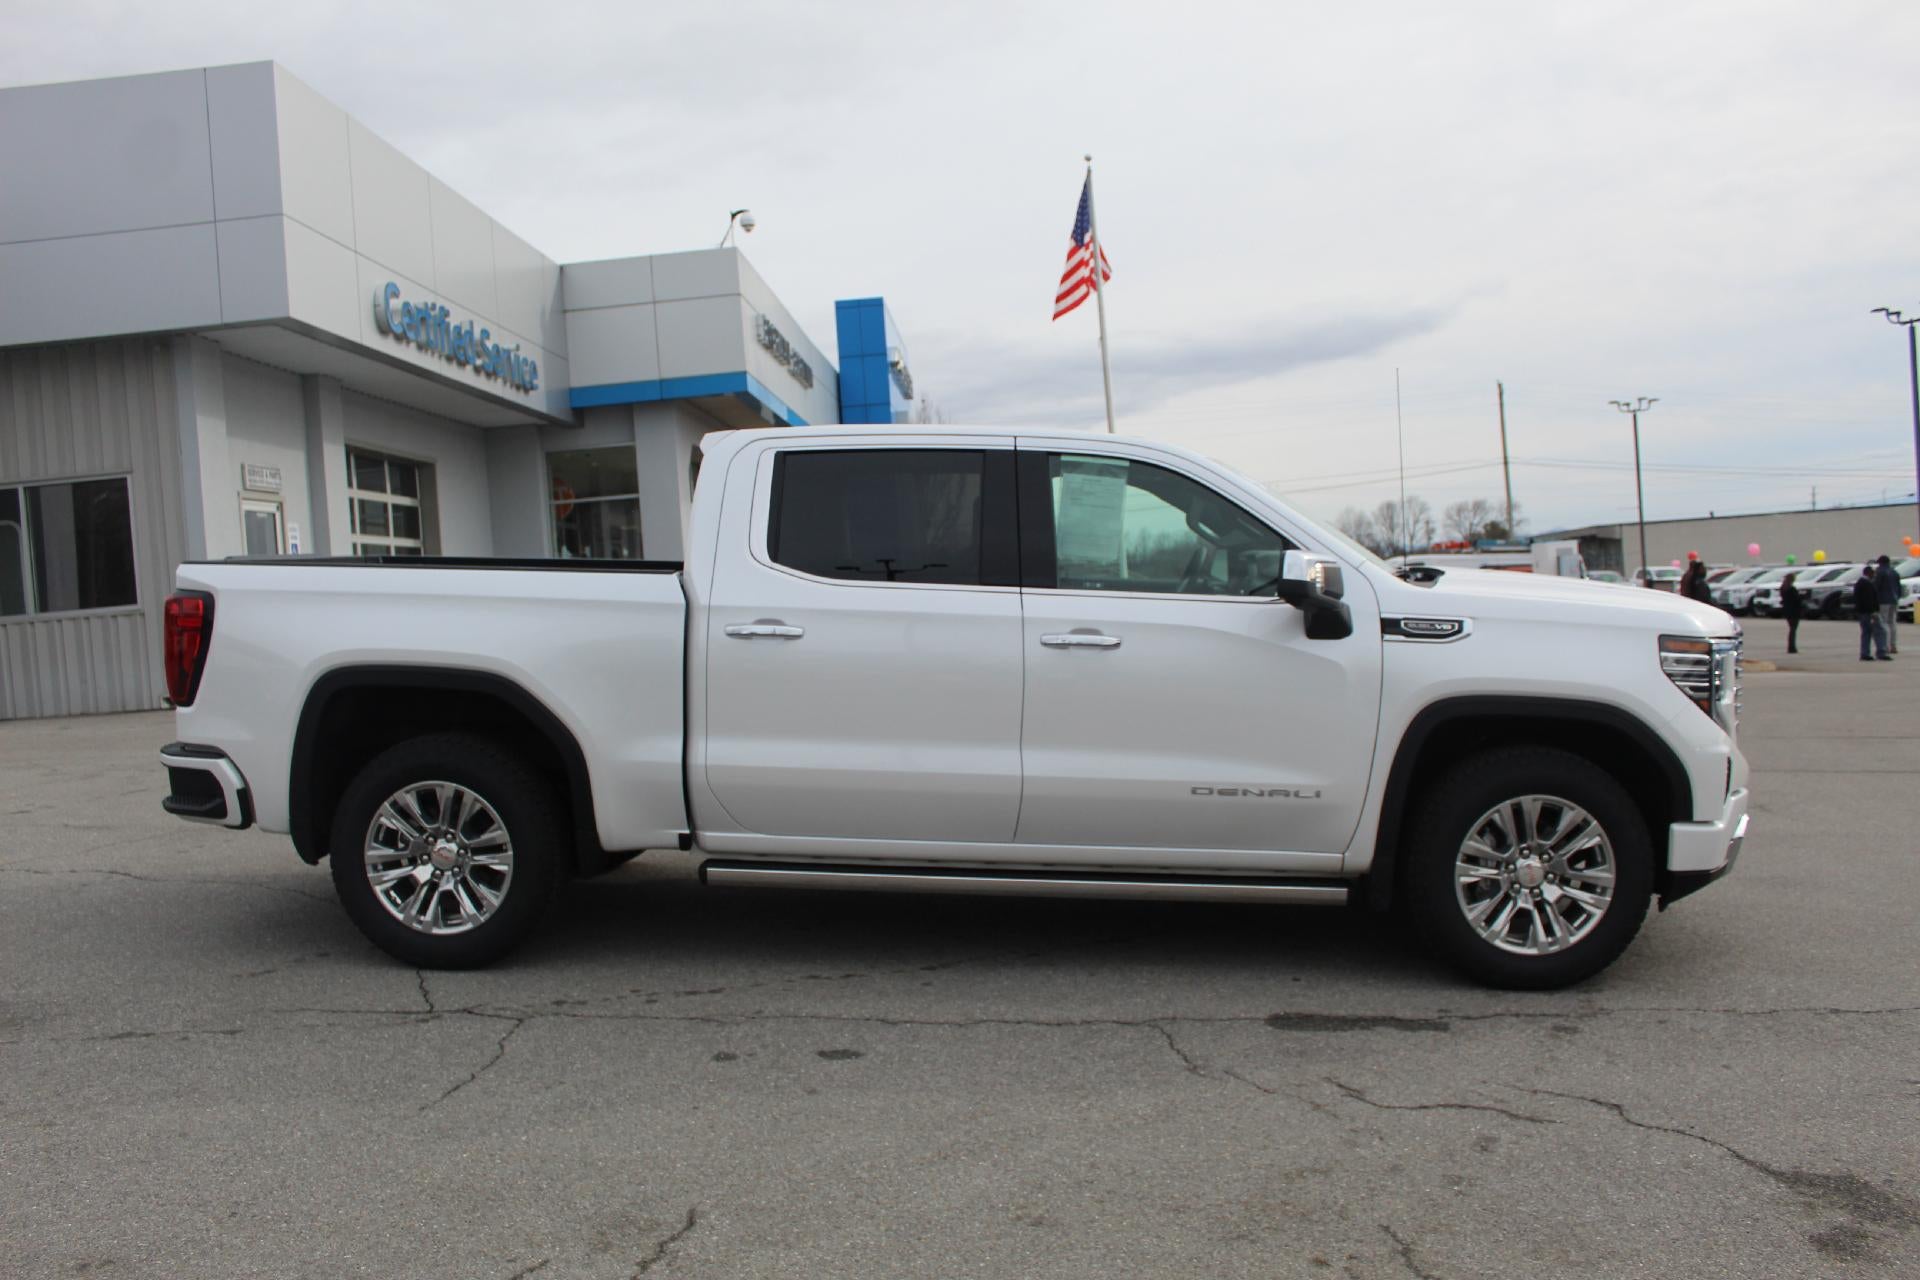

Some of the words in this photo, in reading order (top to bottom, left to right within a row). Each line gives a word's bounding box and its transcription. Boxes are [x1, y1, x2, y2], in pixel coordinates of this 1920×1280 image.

[375, 281, 477, 367] Certified
[478, 327, 540, 392] Service
[1190, 786, 1321, 799] DENALI
